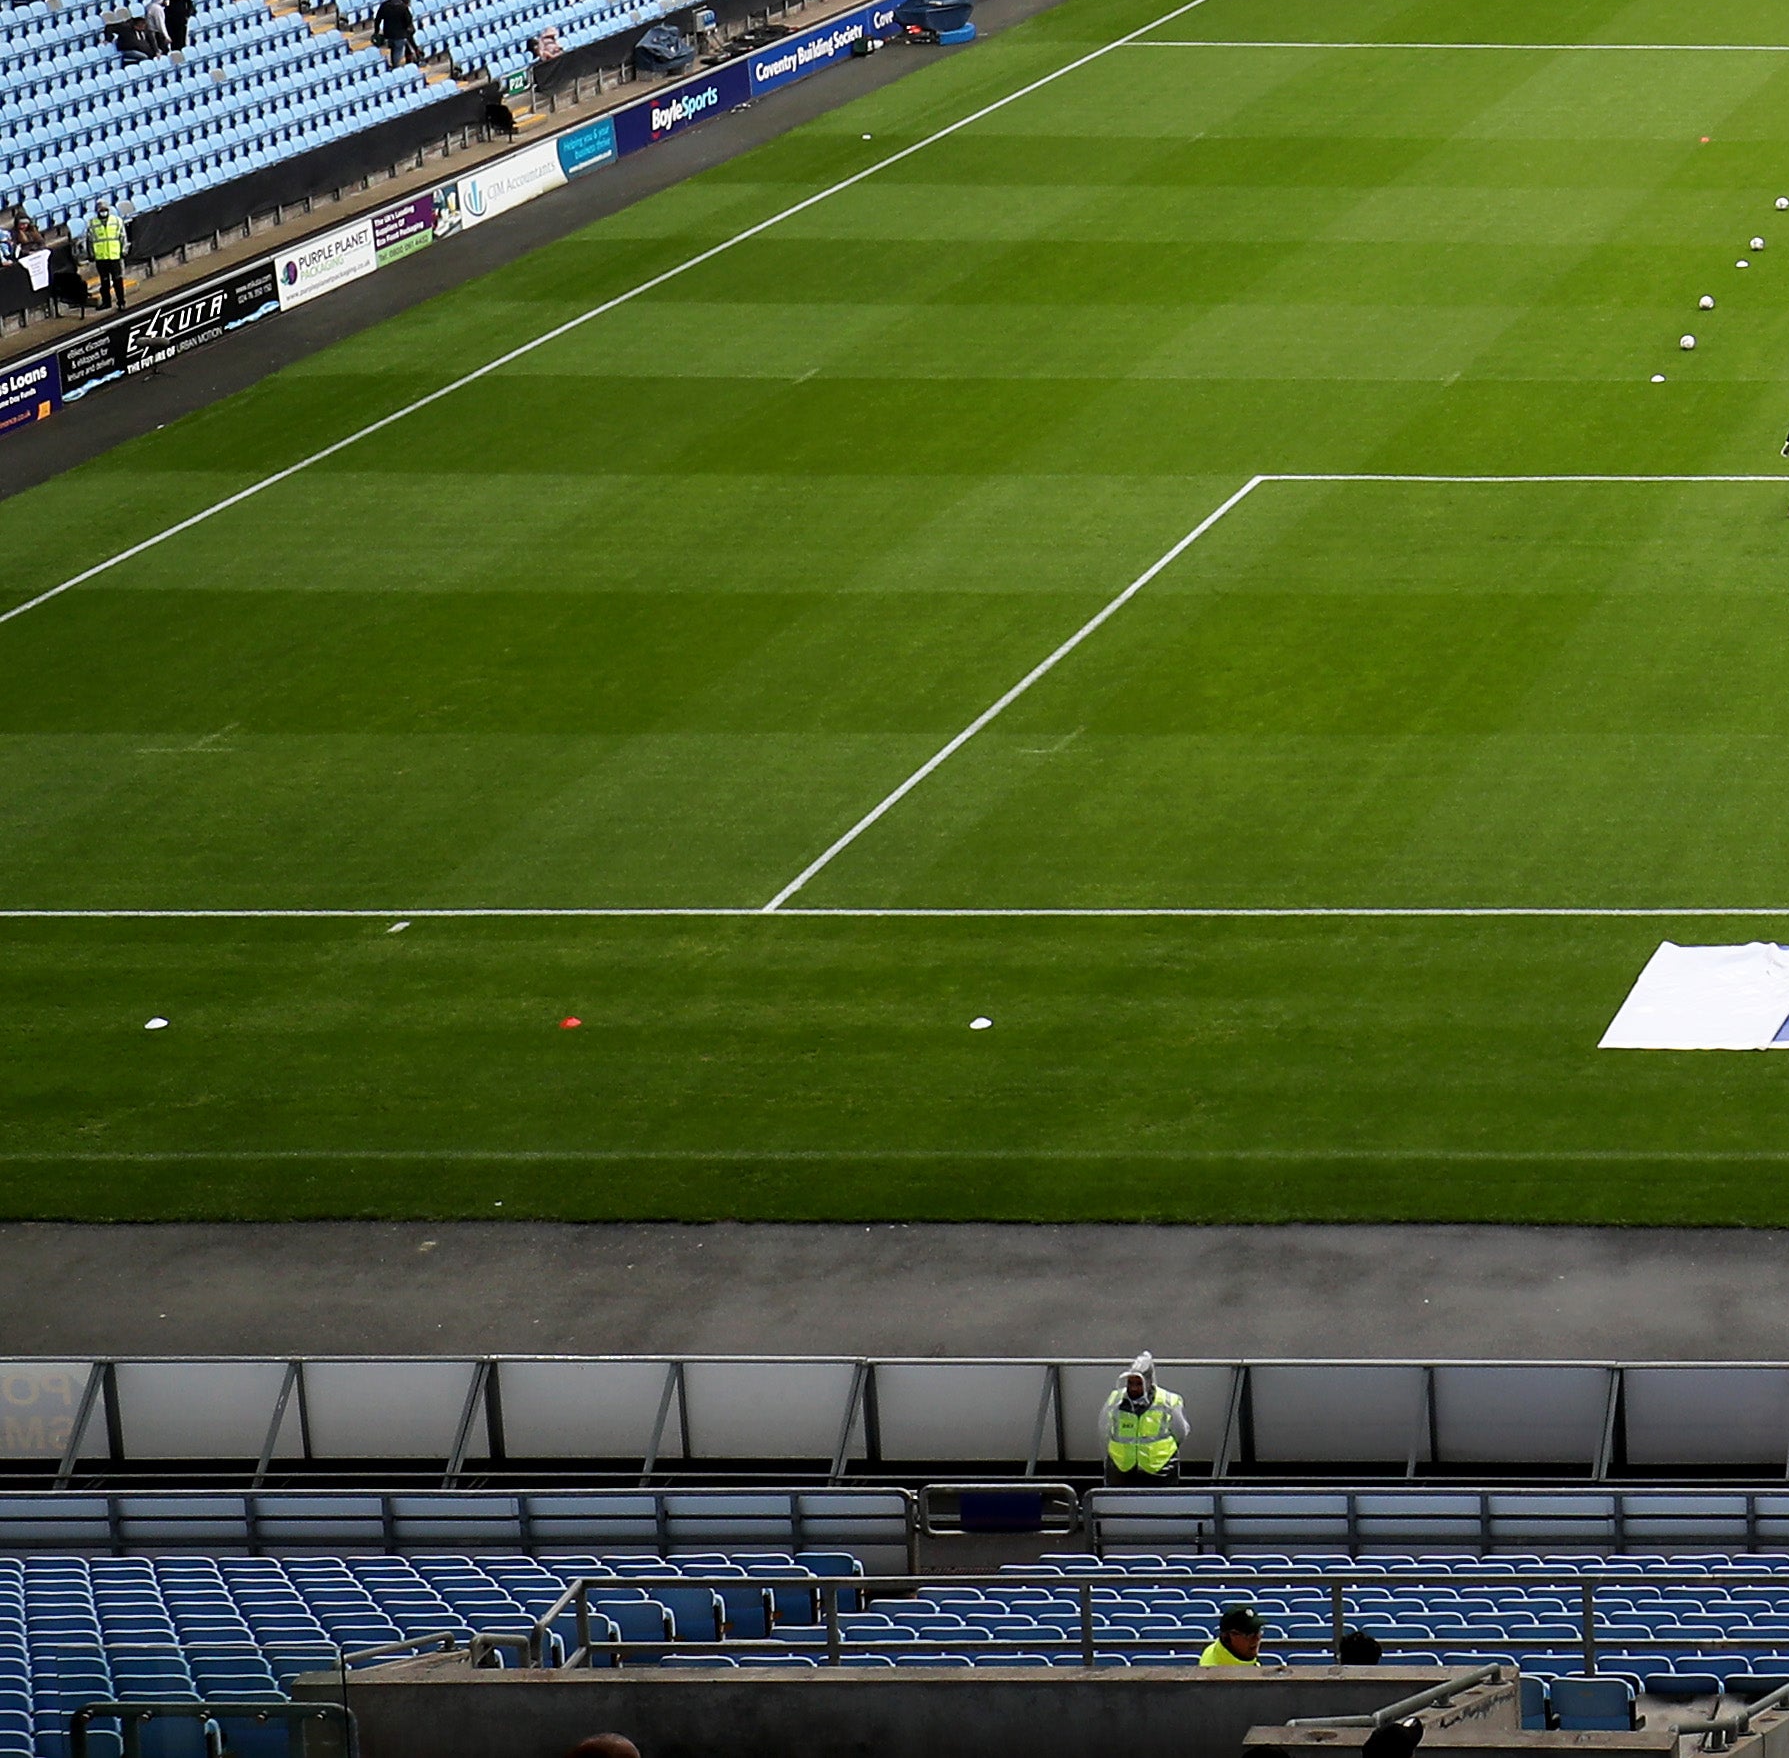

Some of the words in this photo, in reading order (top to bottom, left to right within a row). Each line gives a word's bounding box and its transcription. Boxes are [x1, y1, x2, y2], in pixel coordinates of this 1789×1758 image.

[756, 51, 798, 83] Coventry
[797, 34, 835, 65] Building
[833, 23, 863, 48] Society
[509, 75, 524, 91] P22
[652, 86, 718, 131] BoyleSports
[506, 161, 556, 192] Accountants
[299, 244, 333, 270] PURPLE
[334, 228, 369, 256] PLANET
[300, 256, 345, 280] PACKAGING
[9, 365, 48, 391] Loans
